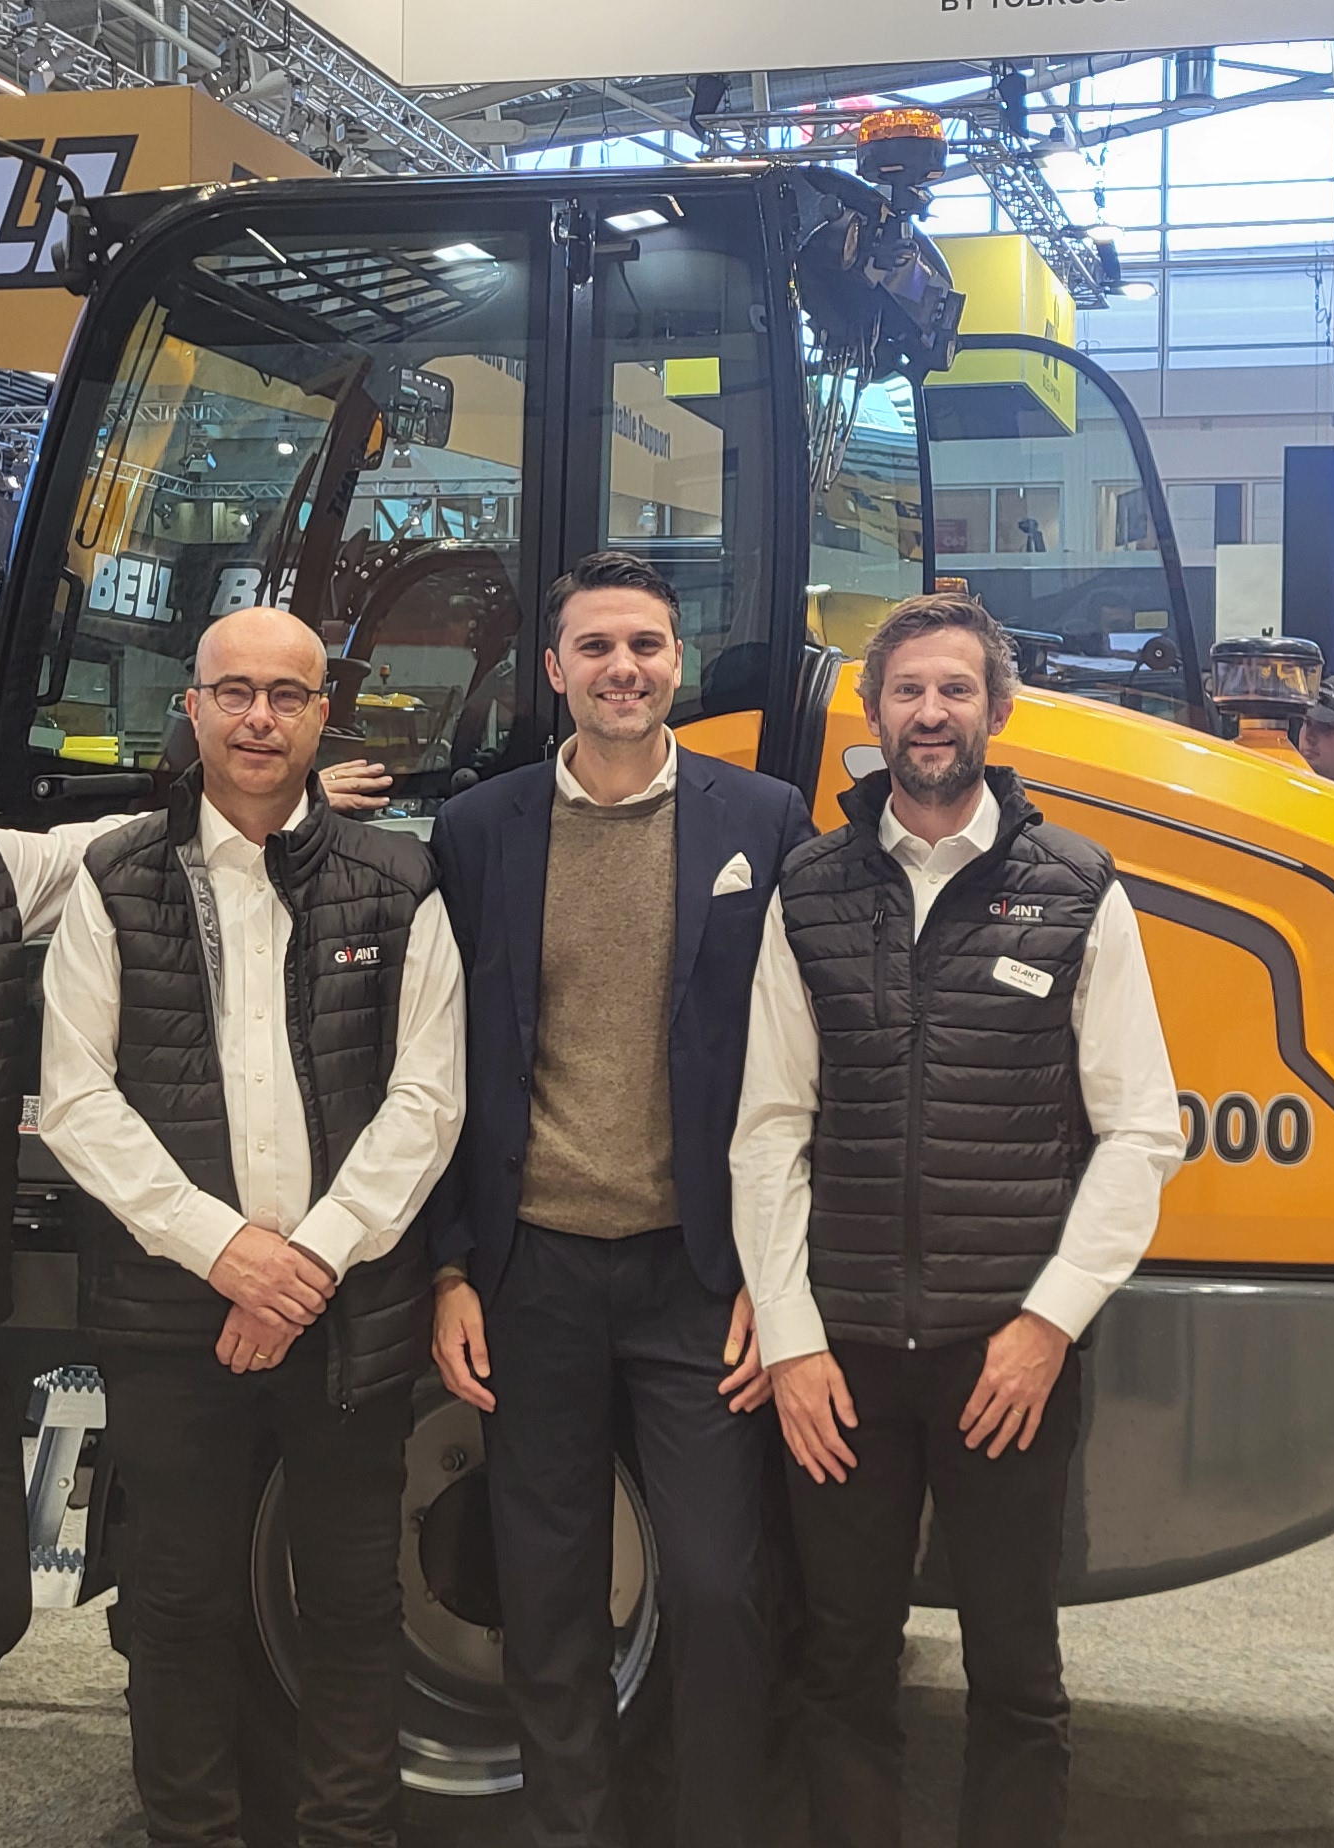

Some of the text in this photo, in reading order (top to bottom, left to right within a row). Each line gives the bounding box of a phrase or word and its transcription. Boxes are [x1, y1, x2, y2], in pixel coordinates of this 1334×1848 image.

[638, 413, 671, 460] Support
[88, 551, 176, 623] BELL
[989, 900, 1044, 917] GIANT
